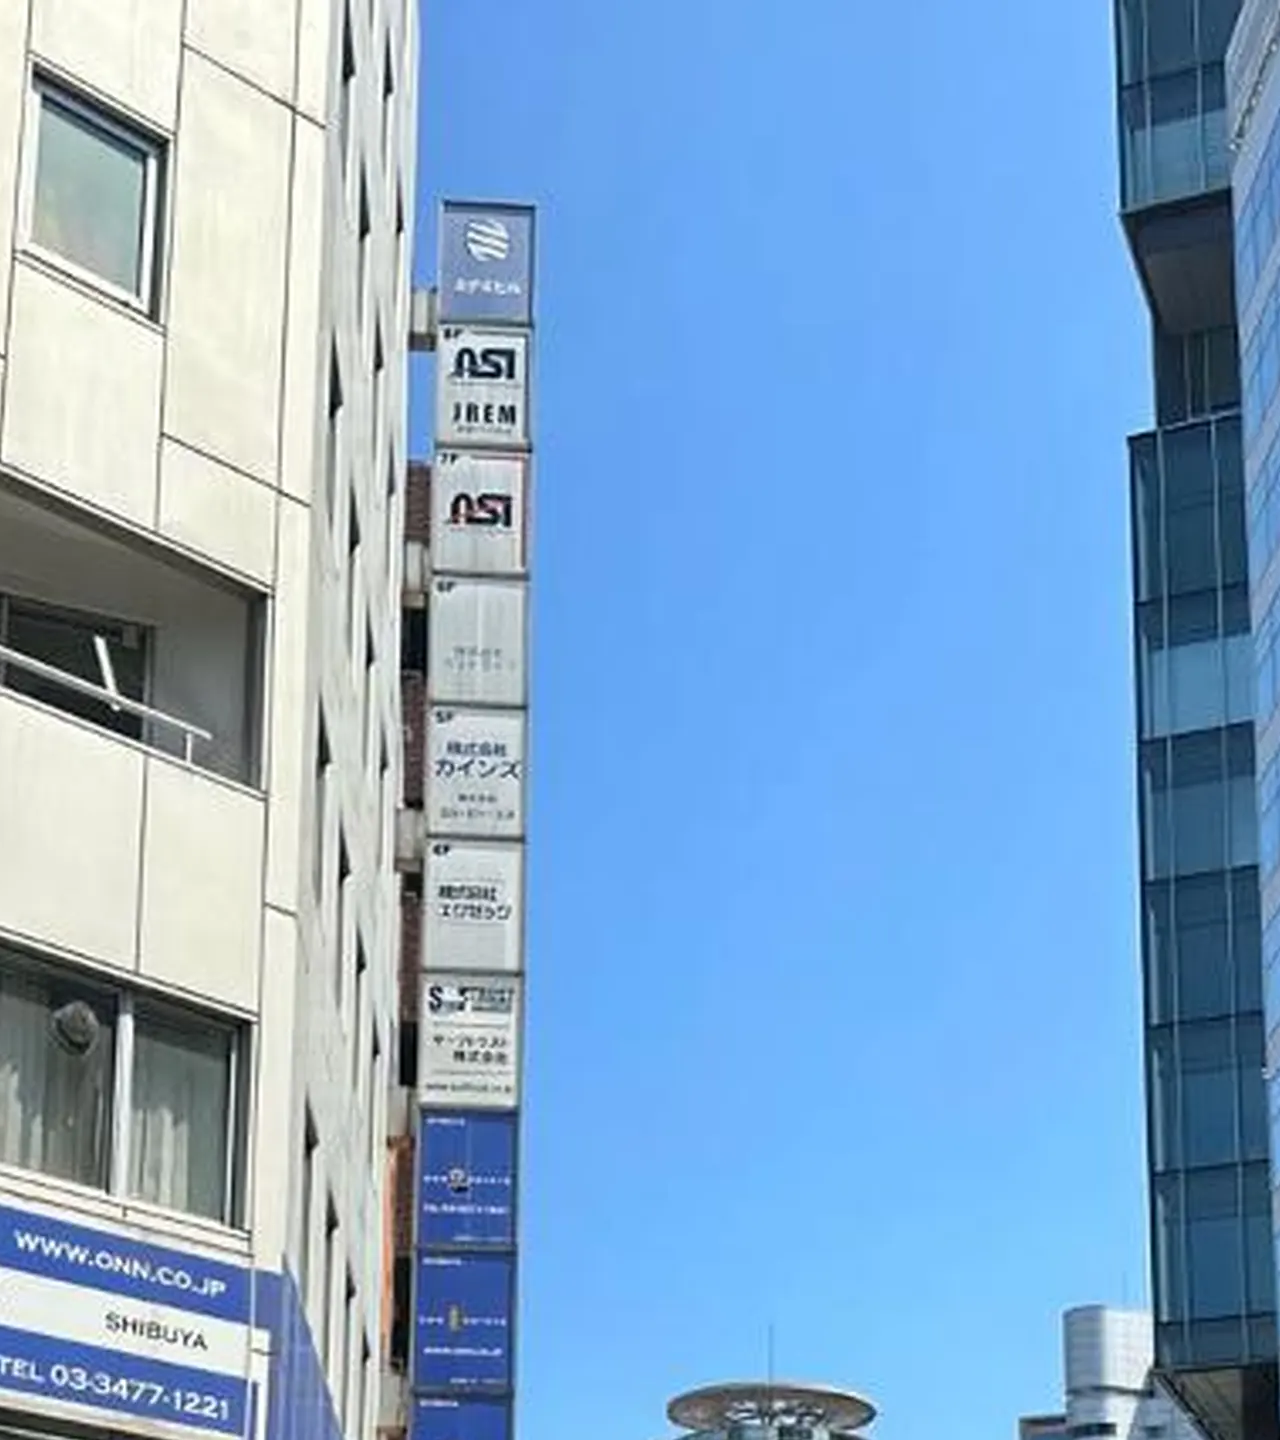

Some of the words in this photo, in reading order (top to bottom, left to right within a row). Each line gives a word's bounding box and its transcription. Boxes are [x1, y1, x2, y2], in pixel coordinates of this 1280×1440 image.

[13, 1229, 227, 1298] WWW.ONN.CO.JP
[104, 1311, 208, 1351] SHIBUYA
[50, 1363, 230, 1420] 03-3477-1221
